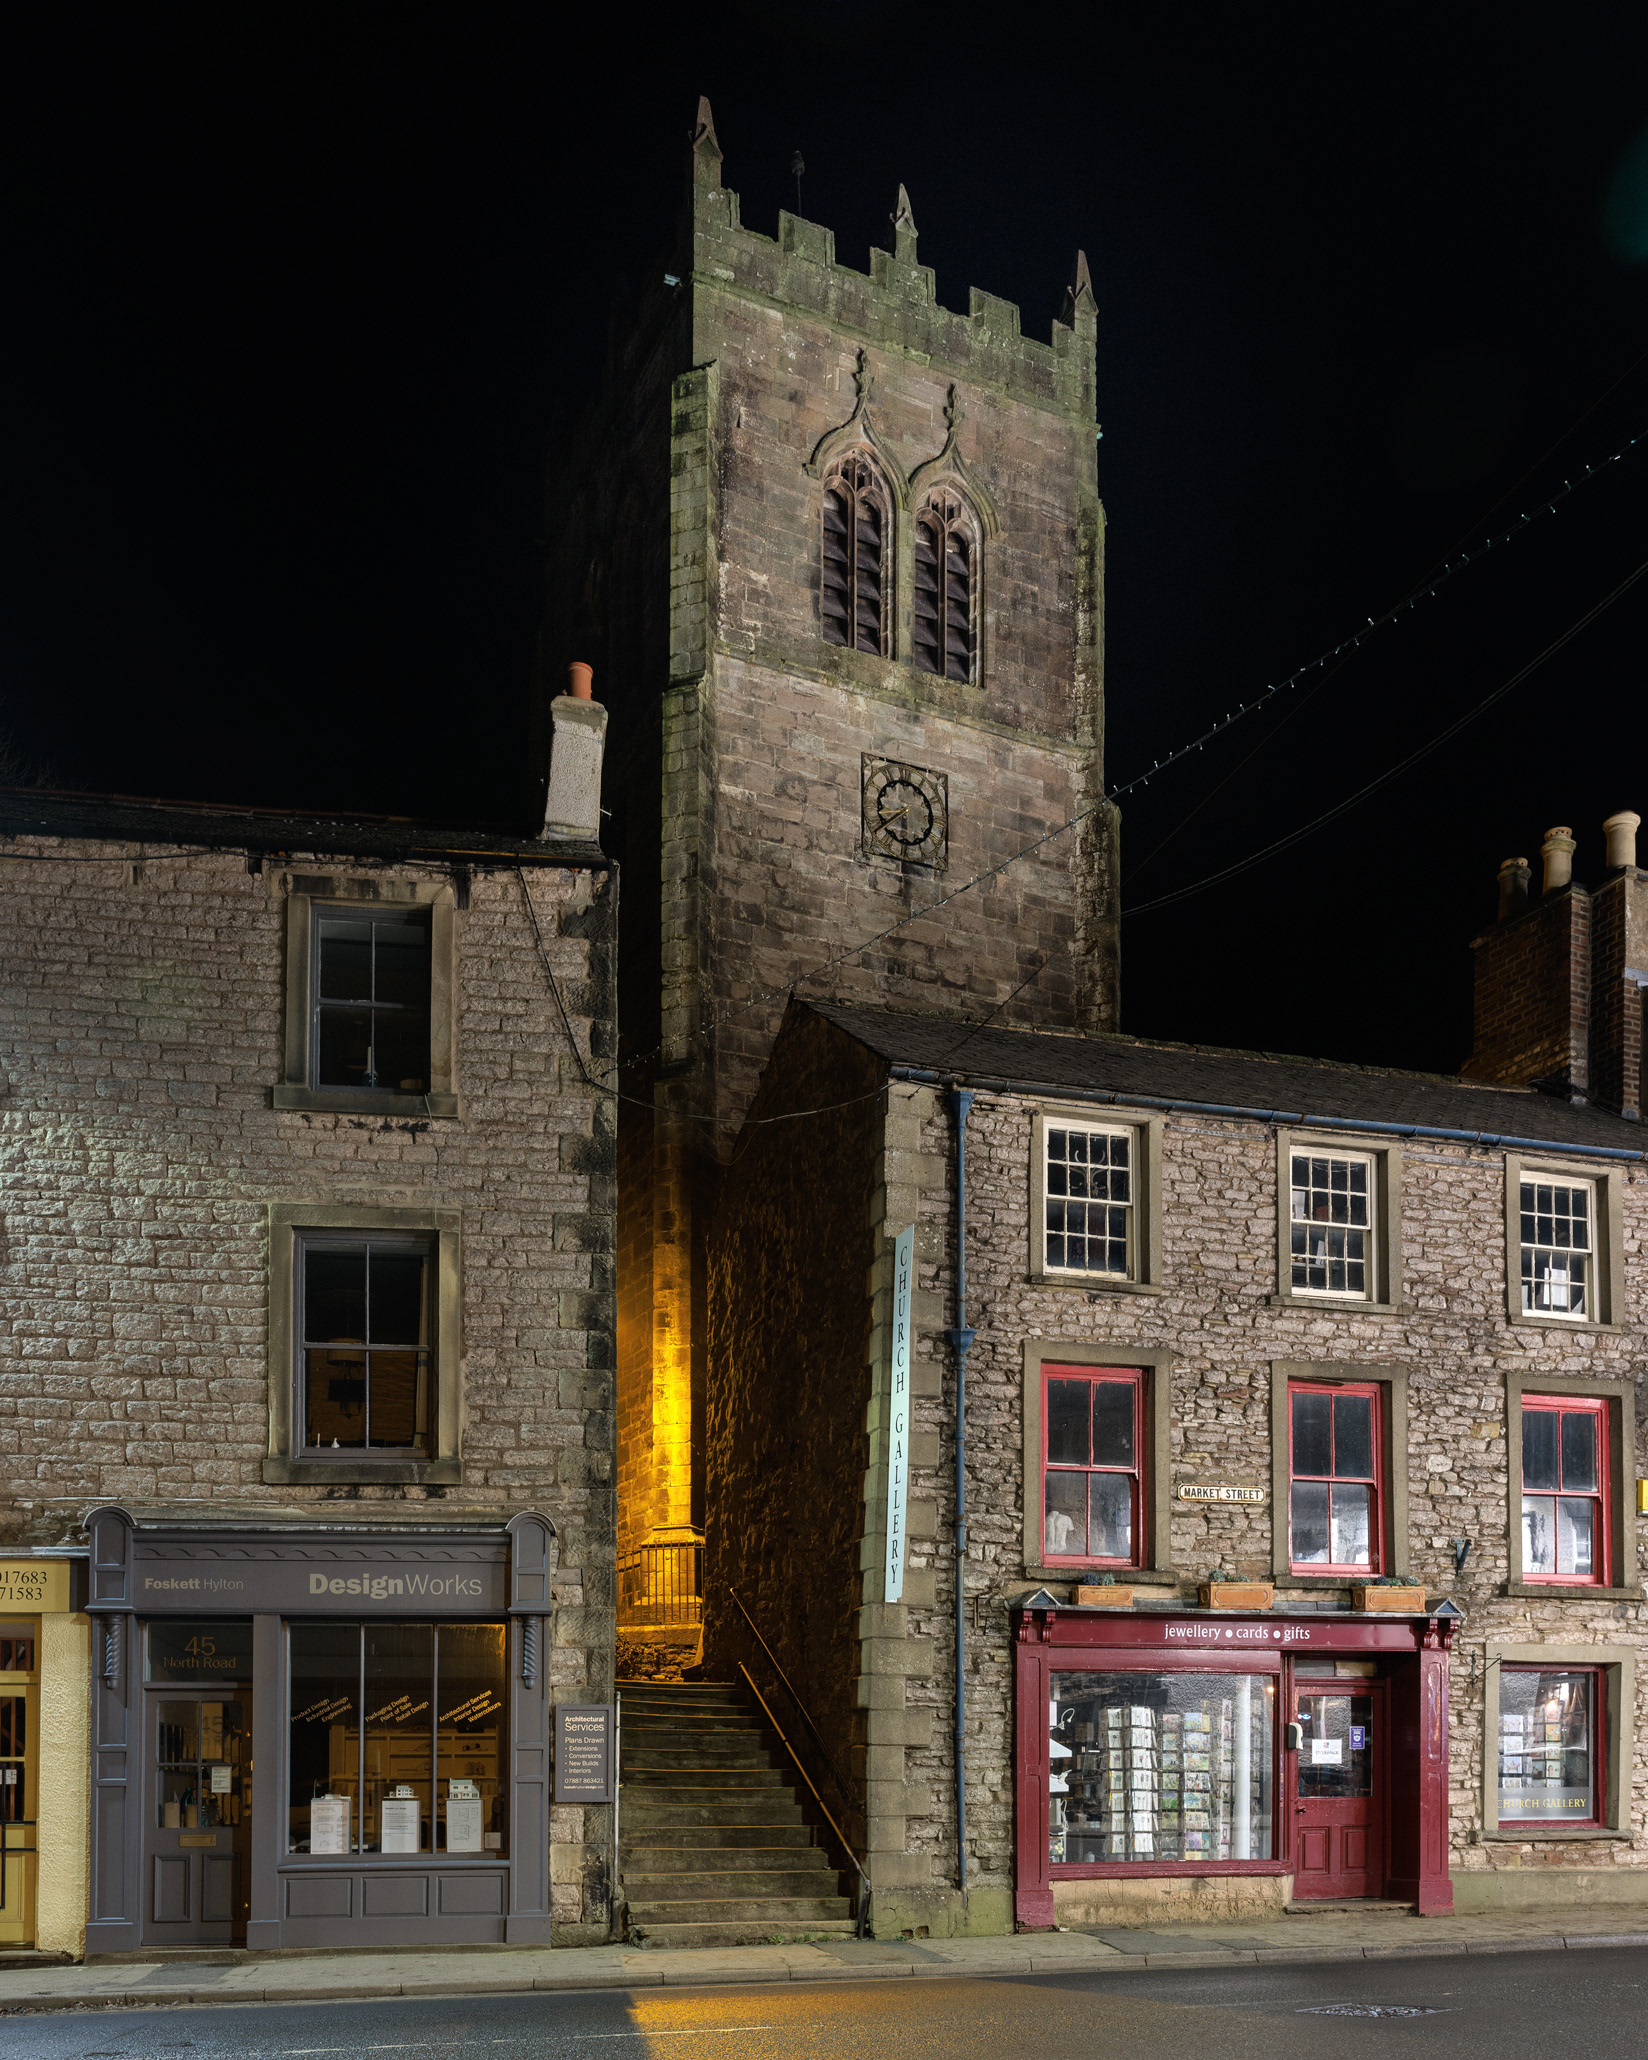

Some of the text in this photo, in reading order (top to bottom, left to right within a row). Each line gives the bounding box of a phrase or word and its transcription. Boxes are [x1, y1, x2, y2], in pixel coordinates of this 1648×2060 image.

[895, 1245, 908, 1394] CHURCH
[891, 1412, 904, 1585] GALLERY
[1184, 1487, 1260, 1499] MARKET STREET
[144, 1577, 244, 1593] Foskett Hylton
[309, 1573, 483, 1600] DesignWorks
[1164, 1624, 1311, 1642] jewellery cards gifts
[184, 1636, 216, 1656] 45
[163, 1656, 237, 1669] North Road
[291, 1698, 330, 1722] Product Design
[306, 1696, 349, 1722] Industrial Design
[321, 1702, 353, 1722] Engineering
[365, 1695, 410, 1722] Packaging Design
[380, 1711, 395, 1722] Point
[399, 1702, 412, 1712] Sale
[395, 1701, 430, 1722] Retail Design
[439, 1690, 492, 1722] Architectural Services
[453, 1699, 490, 1722] Interior Design
[467, 1702, 502, 1722] Watercolours
[564, 1722, 605, 1732] Services
[1497, 1798, 1587, 1809] CHURCH GALLERY
